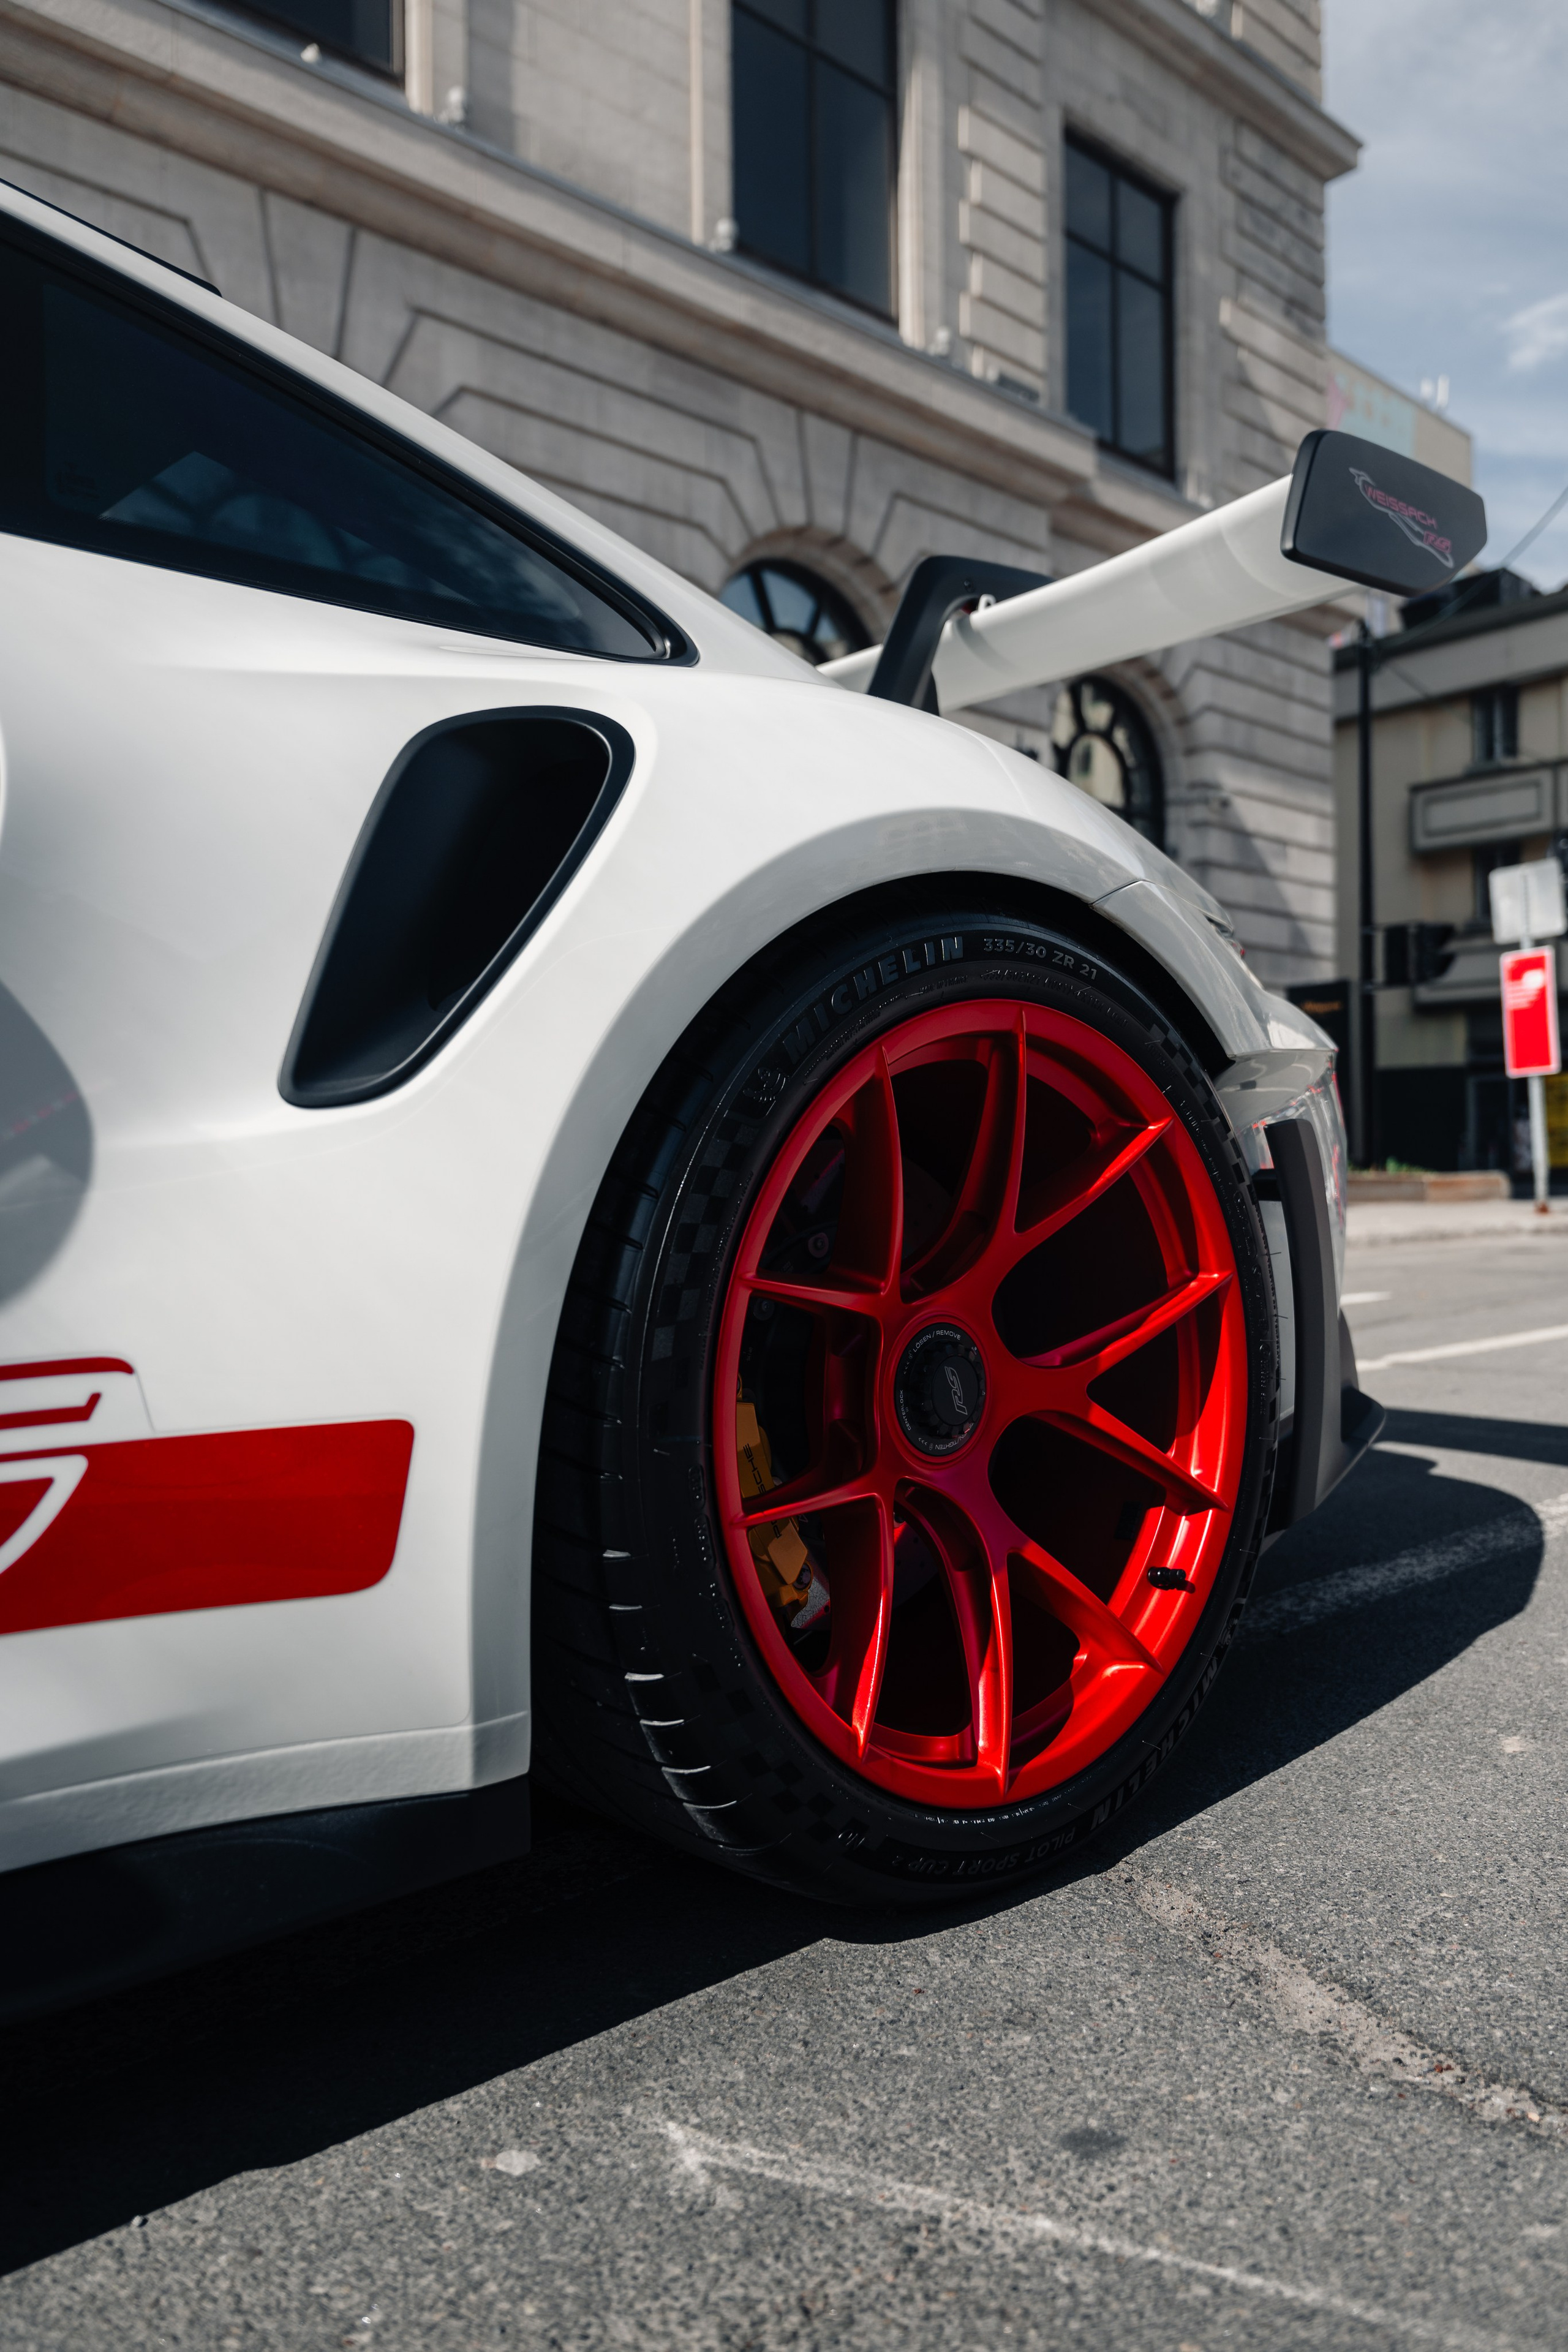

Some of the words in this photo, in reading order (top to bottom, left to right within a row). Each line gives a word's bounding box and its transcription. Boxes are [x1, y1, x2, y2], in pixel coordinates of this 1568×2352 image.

[1365, 485, 1438, 529] WEISSACH
[983, 938, 1047, 959] 335/30
[1052, 950, 1075, 970] ZR
[1079, 963, 1098, 981] 21
[782, 935, 964, 1066] MICHELIN
[912, 1333, 932, 1353] LÖSEN
[935, 1330, 961, 1341] REMOVE
[900, 1389, 912, 1431] CENTERLOCK
[1090, 1659, 1219, 1831] MICHELIN
[952, 1852, 1021, 1876] SPORT
[1024, 1826, 1076, 1864] PILOT
[908, 1858, 950, 1875] CUP
